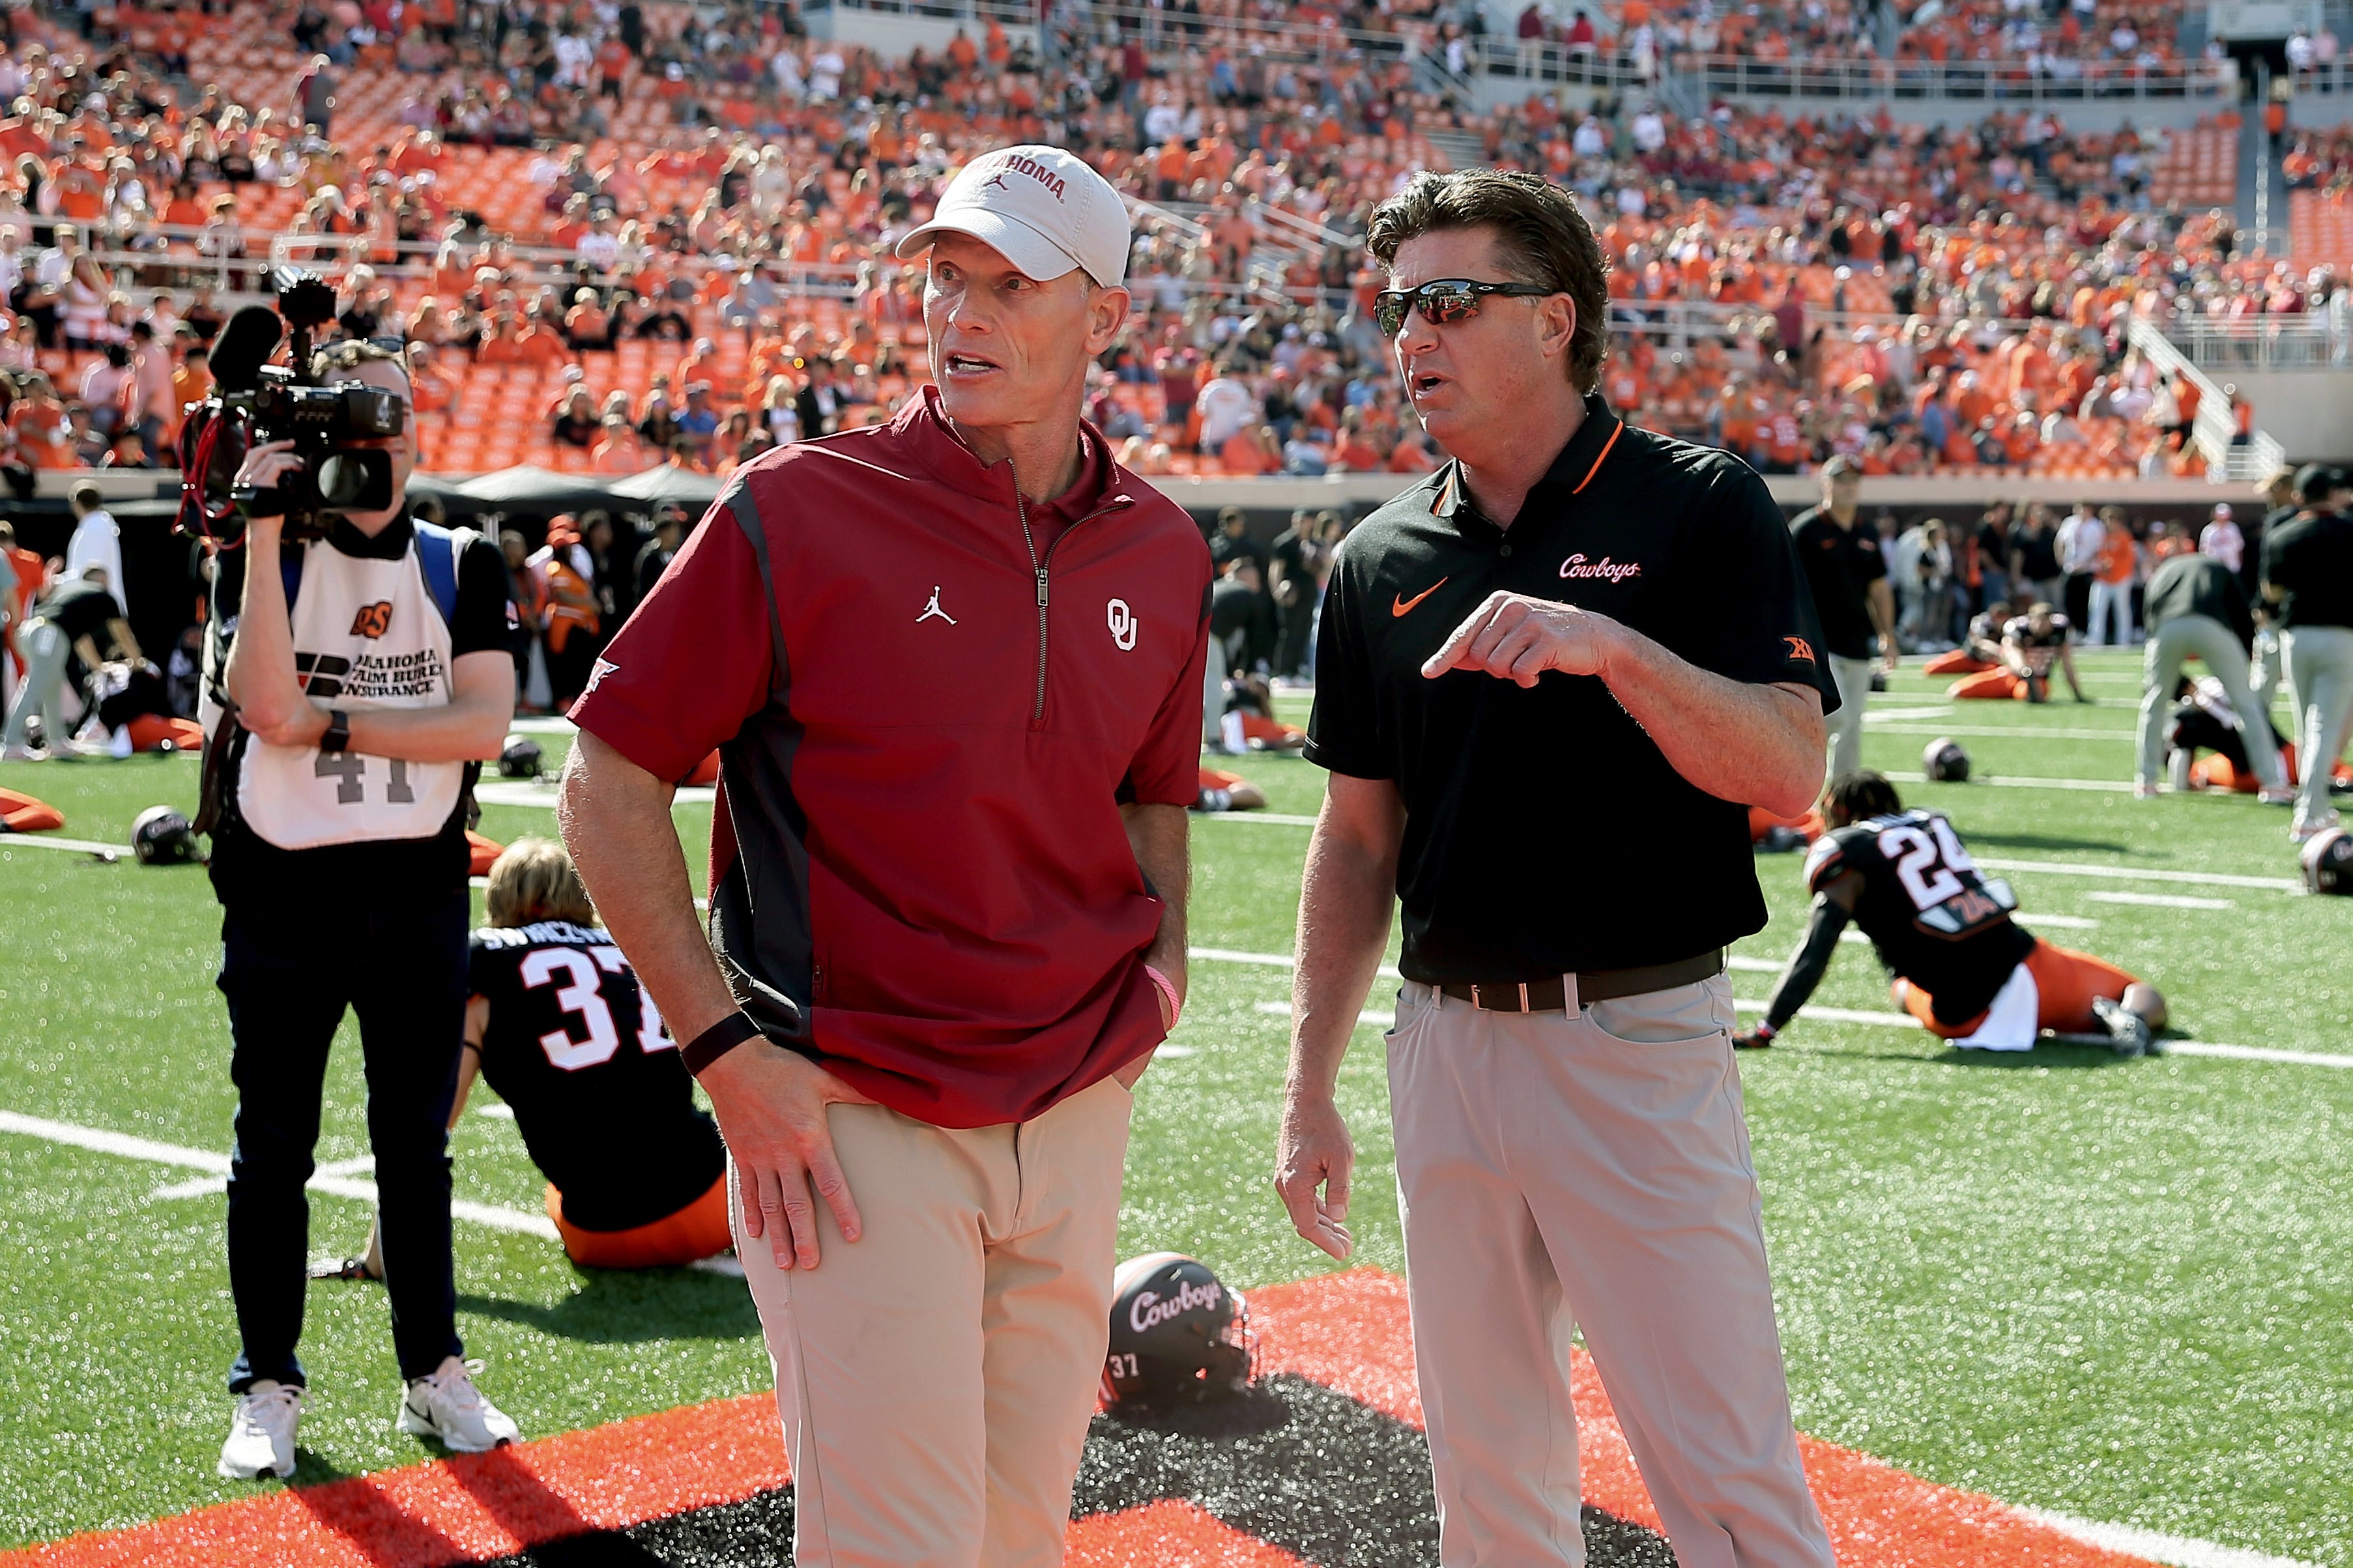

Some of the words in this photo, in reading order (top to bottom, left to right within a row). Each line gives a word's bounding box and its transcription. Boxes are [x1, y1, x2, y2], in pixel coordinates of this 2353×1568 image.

[967, 154, 1065, 200] AHOMA
[1559, 553, 1641, 583] Cowboys
[1107, 598, 1137, 651] OU
[1130, 1280, 1222, 1333] Cowboys
[1109, 1352, 1140, 1379] 37
